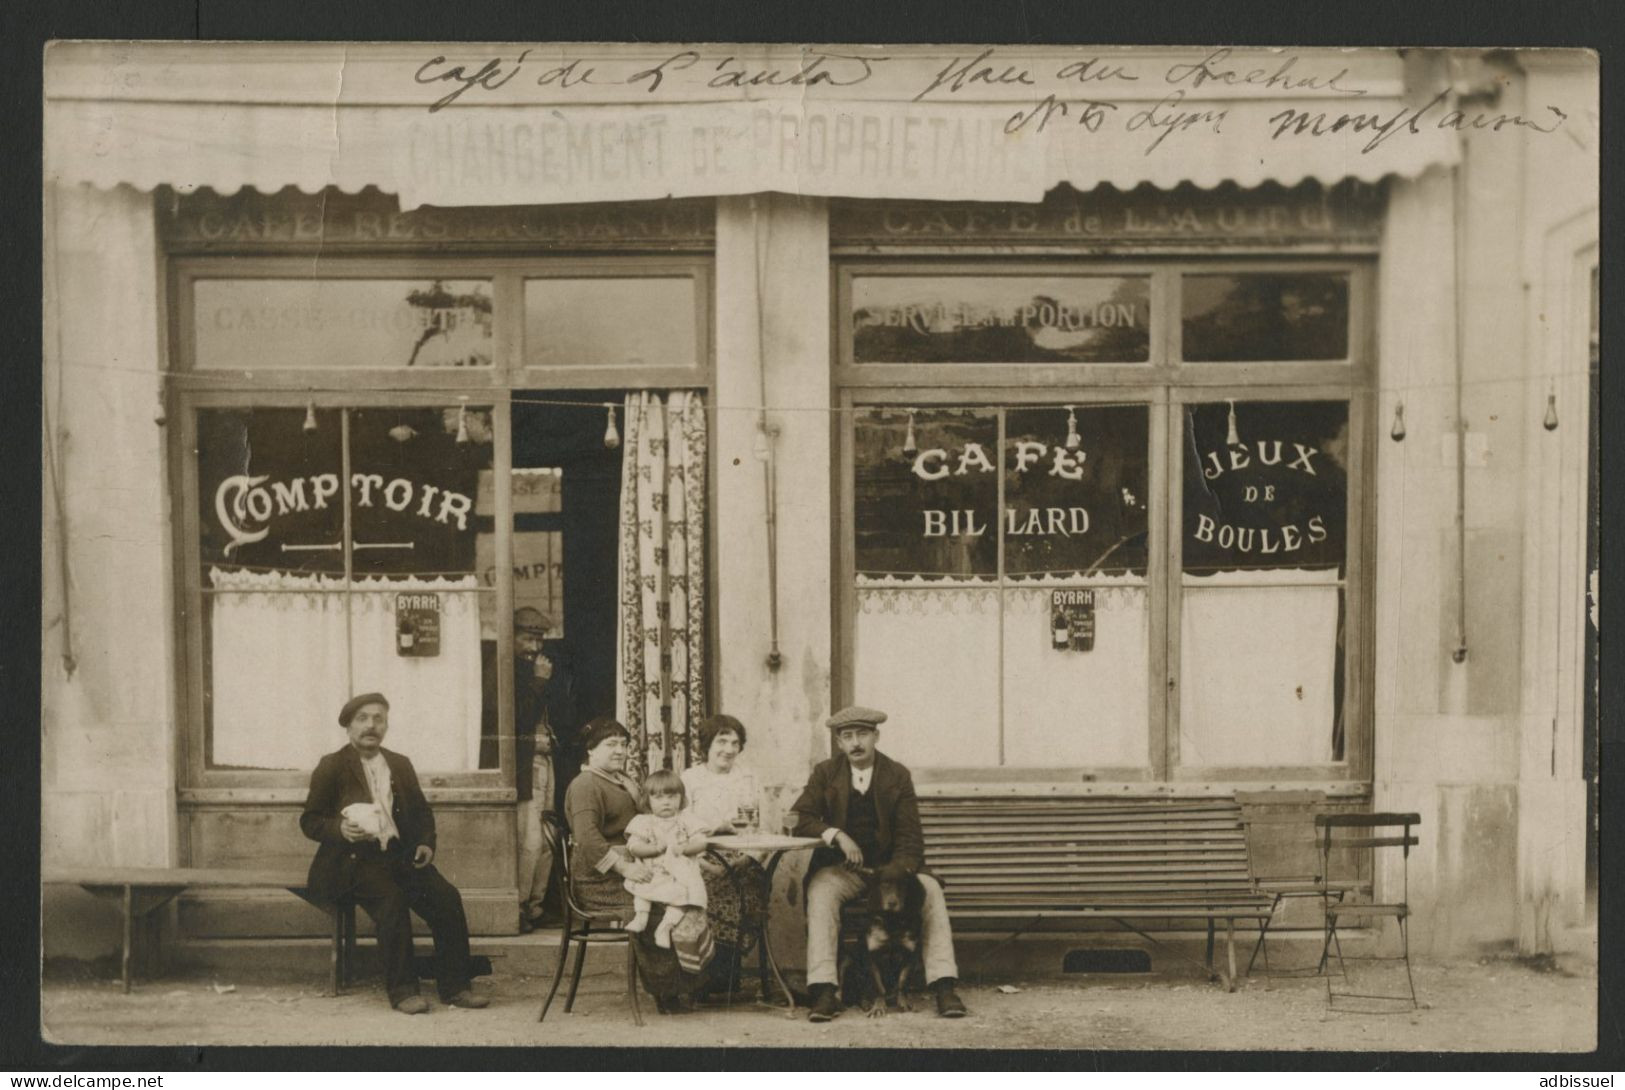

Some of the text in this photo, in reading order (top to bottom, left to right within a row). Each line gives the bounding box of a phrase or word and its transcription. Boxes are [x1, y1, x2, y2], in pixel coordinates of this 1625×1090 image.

[414, 49, 533, 113] Café
[537, 58, 602, 88] de
[692, 126, 730, 176] DE
[1063, 205, 1102, 234] de
[1022, 303, 1136, 332] PORTION
[1244, 485, 1276, 503] DE
[215, 474, 472, 557] COMPTOIR
[1193, 514, 1328, 553] BOULES
[398, 595, 438, 610] BYRRH
[1053, 590, 1093, 605] BYRRH
